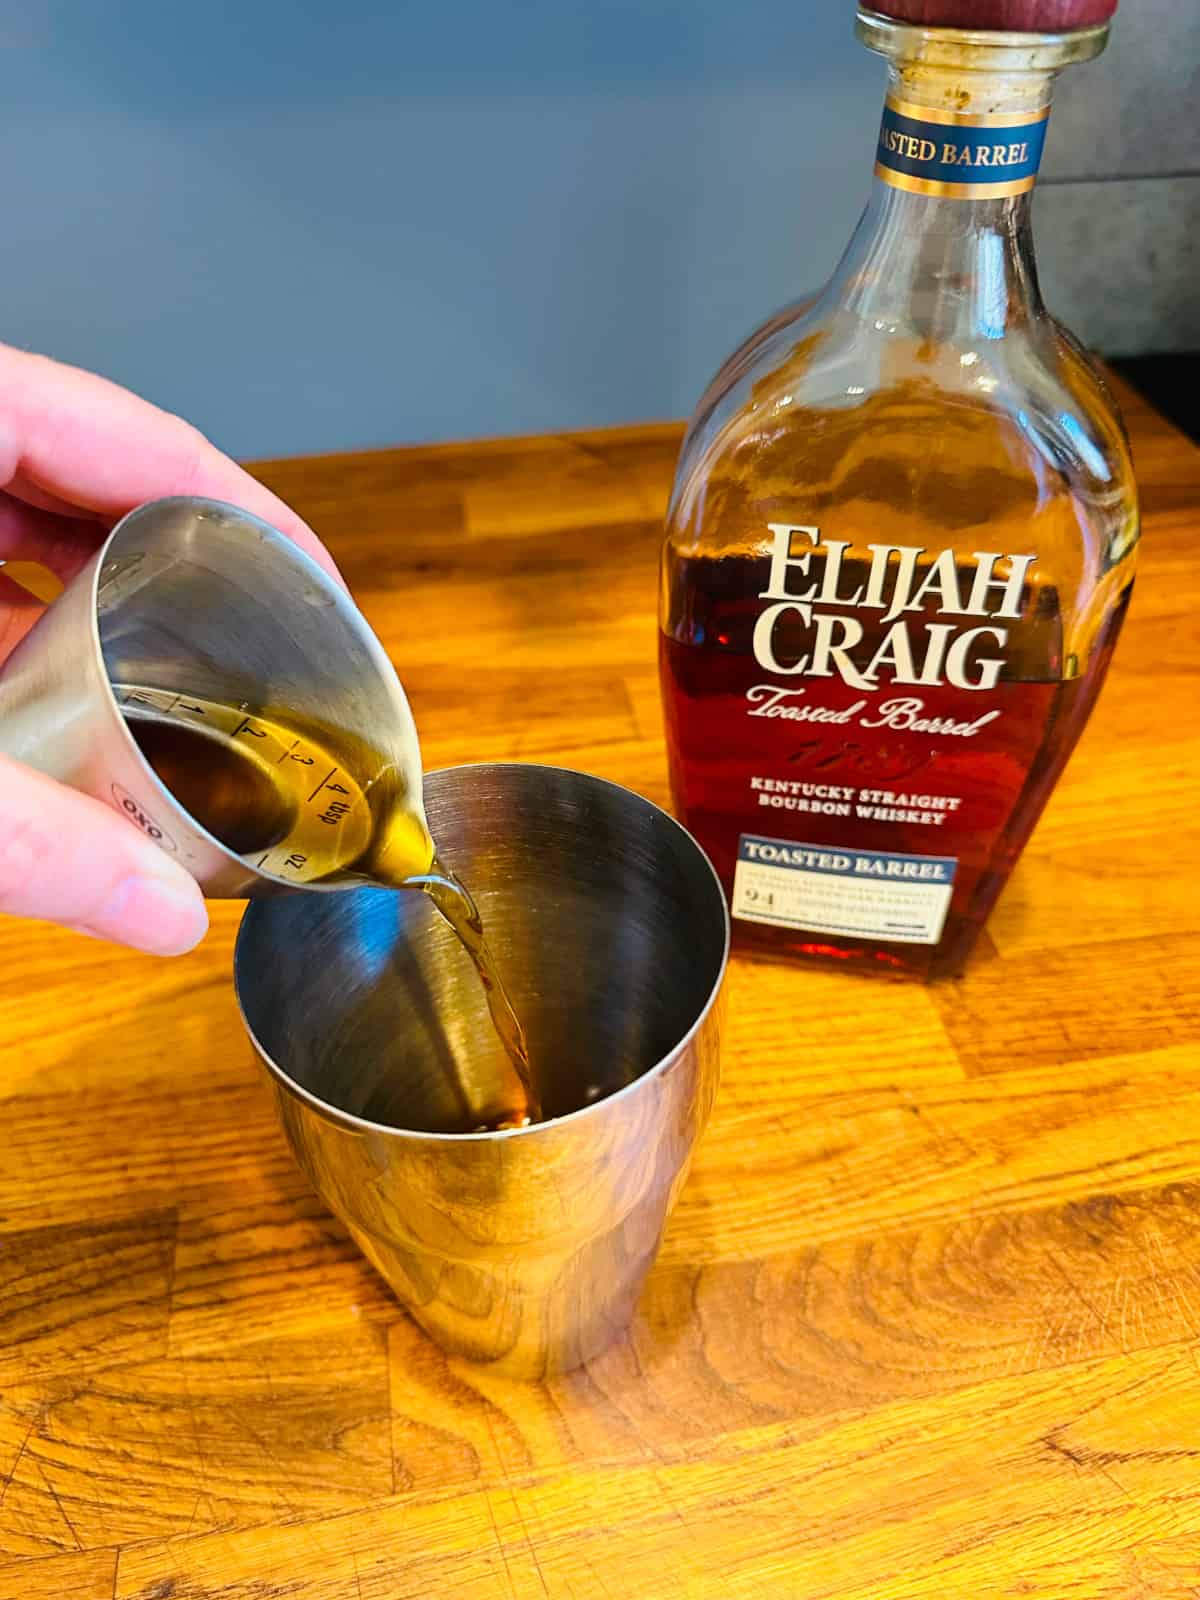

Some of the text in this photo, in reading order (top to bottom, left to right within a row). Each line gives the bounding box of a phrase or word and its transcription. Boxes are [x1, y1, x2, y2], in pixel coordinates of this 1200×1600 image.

[940, 143, 1028, 166] BARREL
[759, 522, 1038, 624] ELIJAH
[752, 602, 1009, 691] CRAIG
[746, 684, 1001, 737] Toasted Barrel
[242, 727, 267, 738] 2
[290, 754, 315, 765] 3
[317, 783, 351, 825] 4 tbsp
[750, 776, 961, 811] KENTUCKY STRAIGHT
[757, 793, 947, 826] BOURBON WHISKEY
[122, 799, 163, 839] OXO
[744, 841, 946, 881] TOASTED BARREL
